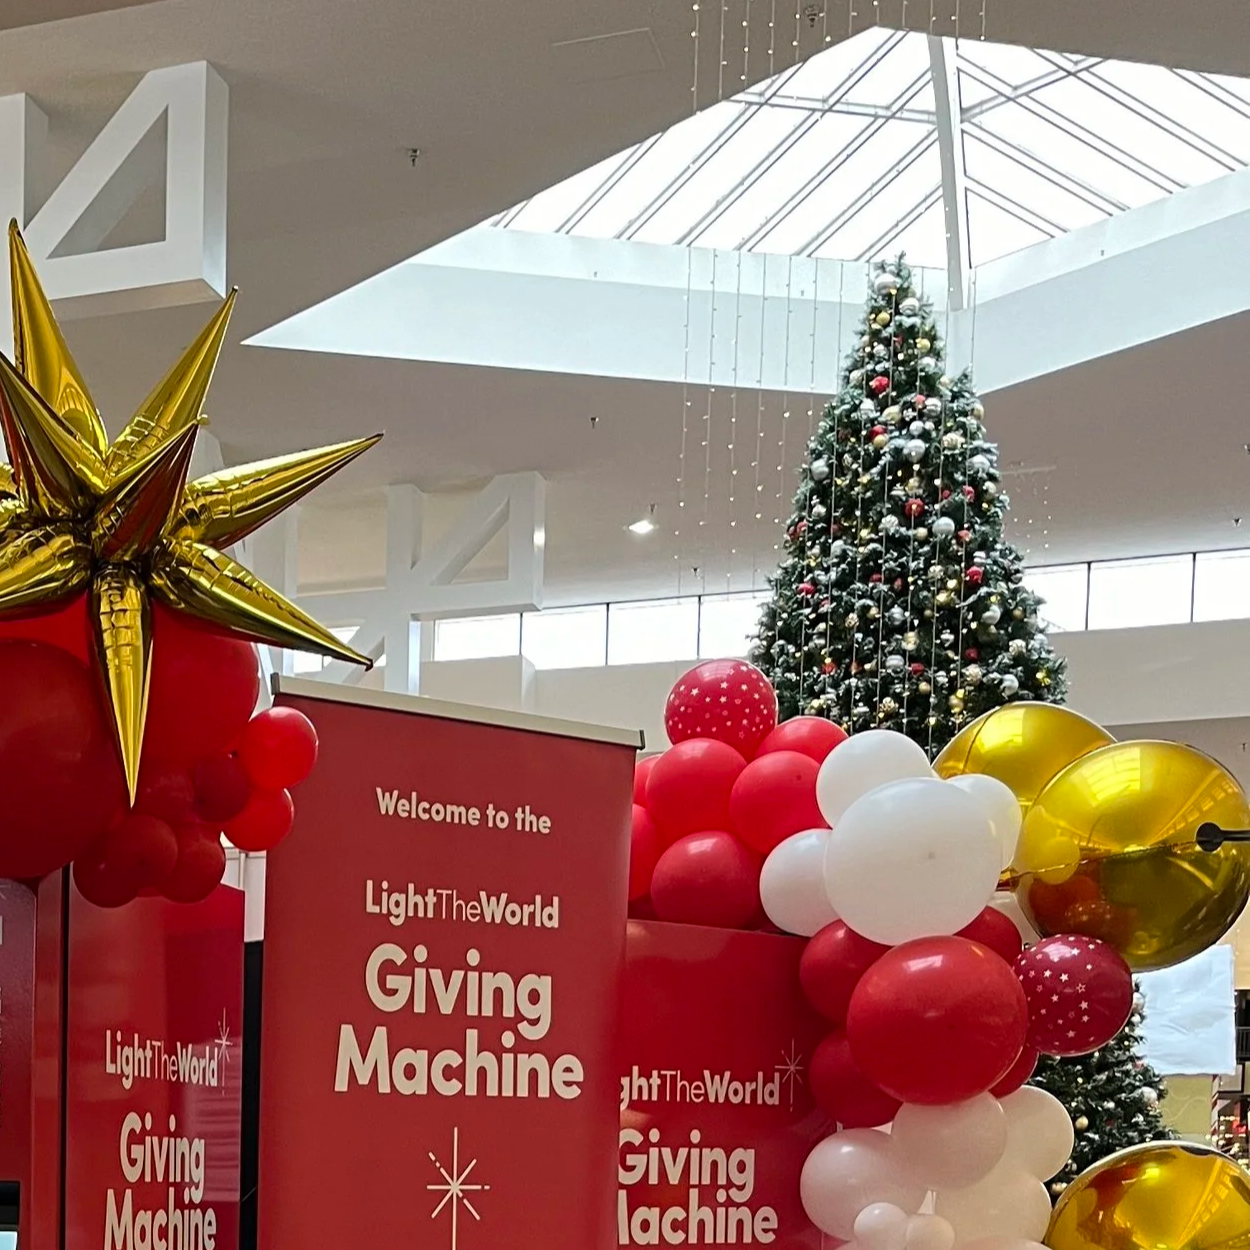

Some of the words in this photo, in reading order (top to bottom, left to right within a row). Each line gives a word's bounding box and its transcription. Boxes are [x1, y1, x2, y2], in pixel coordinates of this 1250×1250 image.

[376, 787, 481, 826] Welcome
[486, 803, 510, 829] to
[514, 805, 552, 834] the
[365, 880, 559, 929] LightTheWorld
[365, 943, 552, 1040] Giving
[105, 1029, 219, 1090] LightTheWorld
[334, 1023, 584, 1100] Machine
[619, 1065, 780, 1111] ghtTheWorld
[120, 1111, 205, 1203] Giving
[618, 1127, 755, 1203] Giving
